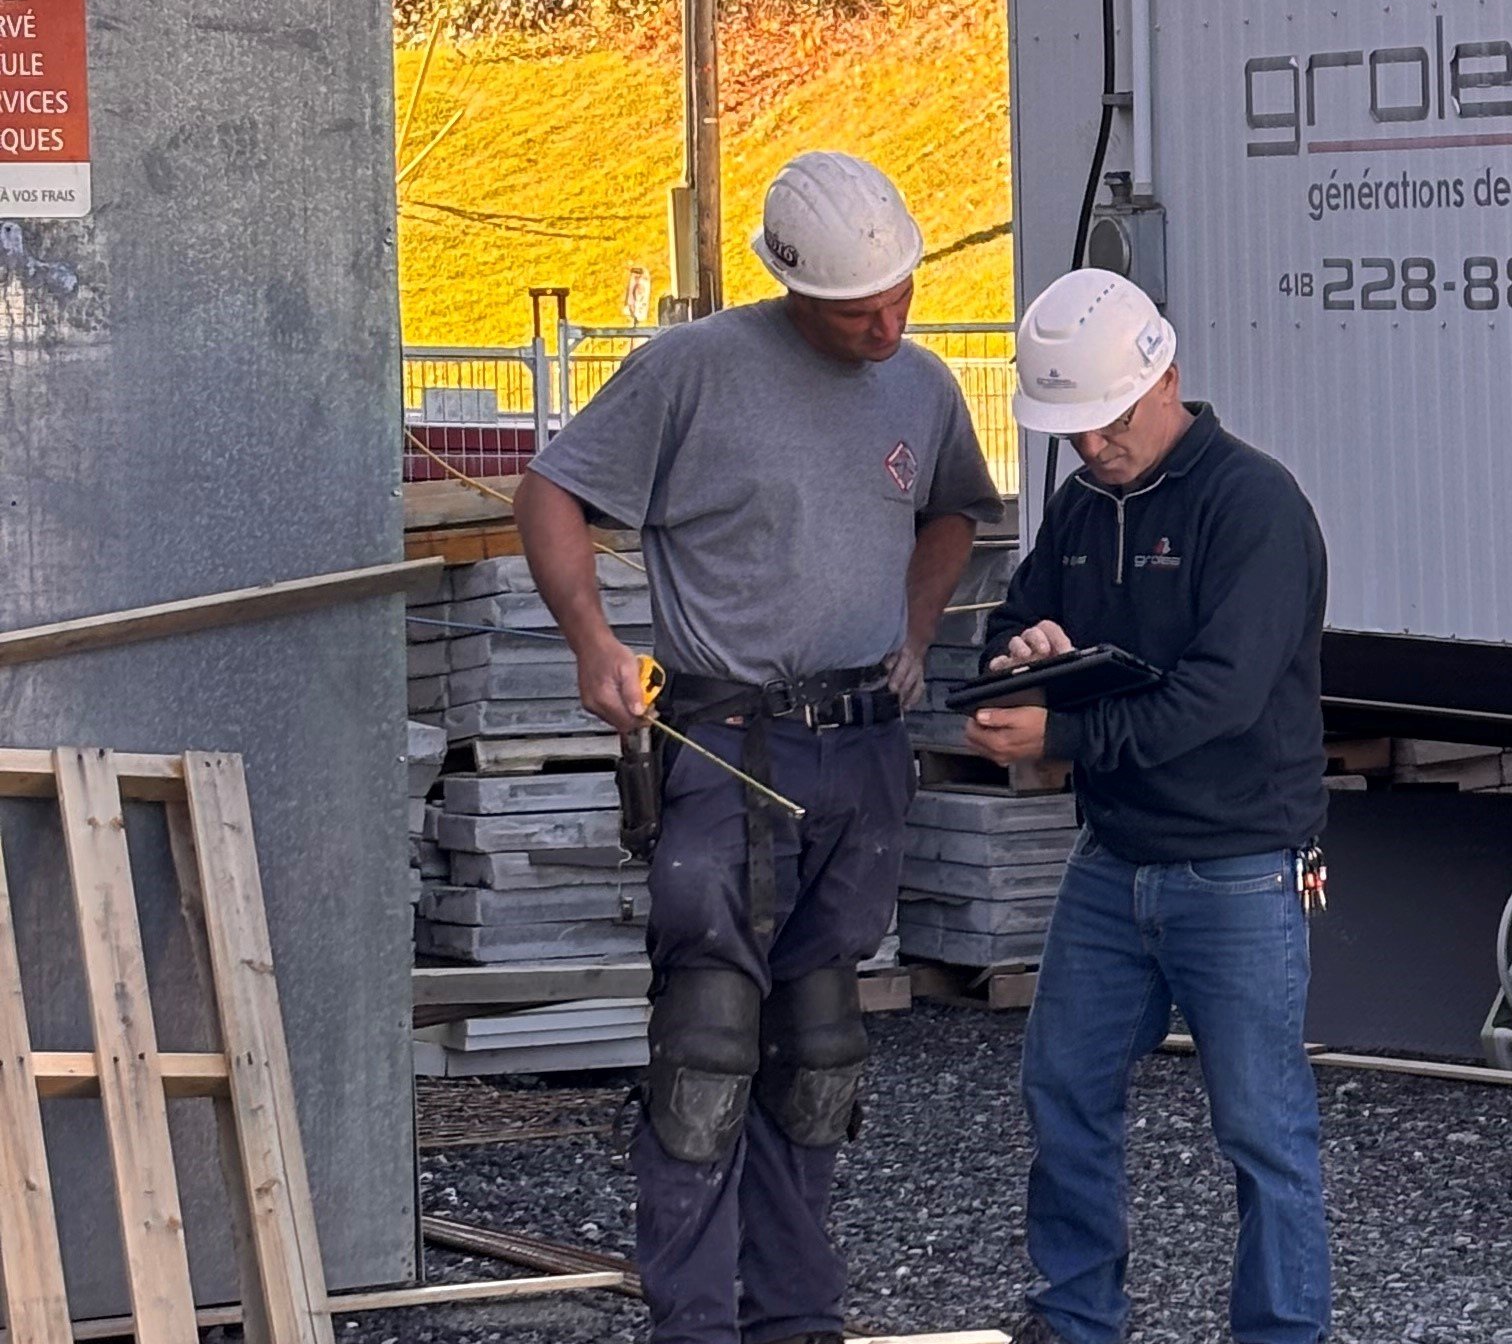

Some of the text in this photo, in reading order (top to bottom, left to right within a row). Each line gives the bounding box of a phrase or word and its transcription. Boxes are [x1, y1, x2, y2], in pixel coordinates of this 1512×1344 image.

[0, 52, 44, 76] ULE
[13, 189, 38, 203] VOS
[41, 189, 75, 203] FRAIS
[1307, 168, 1465, 222] générations
[1473, 167, 1511, 207] de
[1278, 272, 1314, 299] 418
